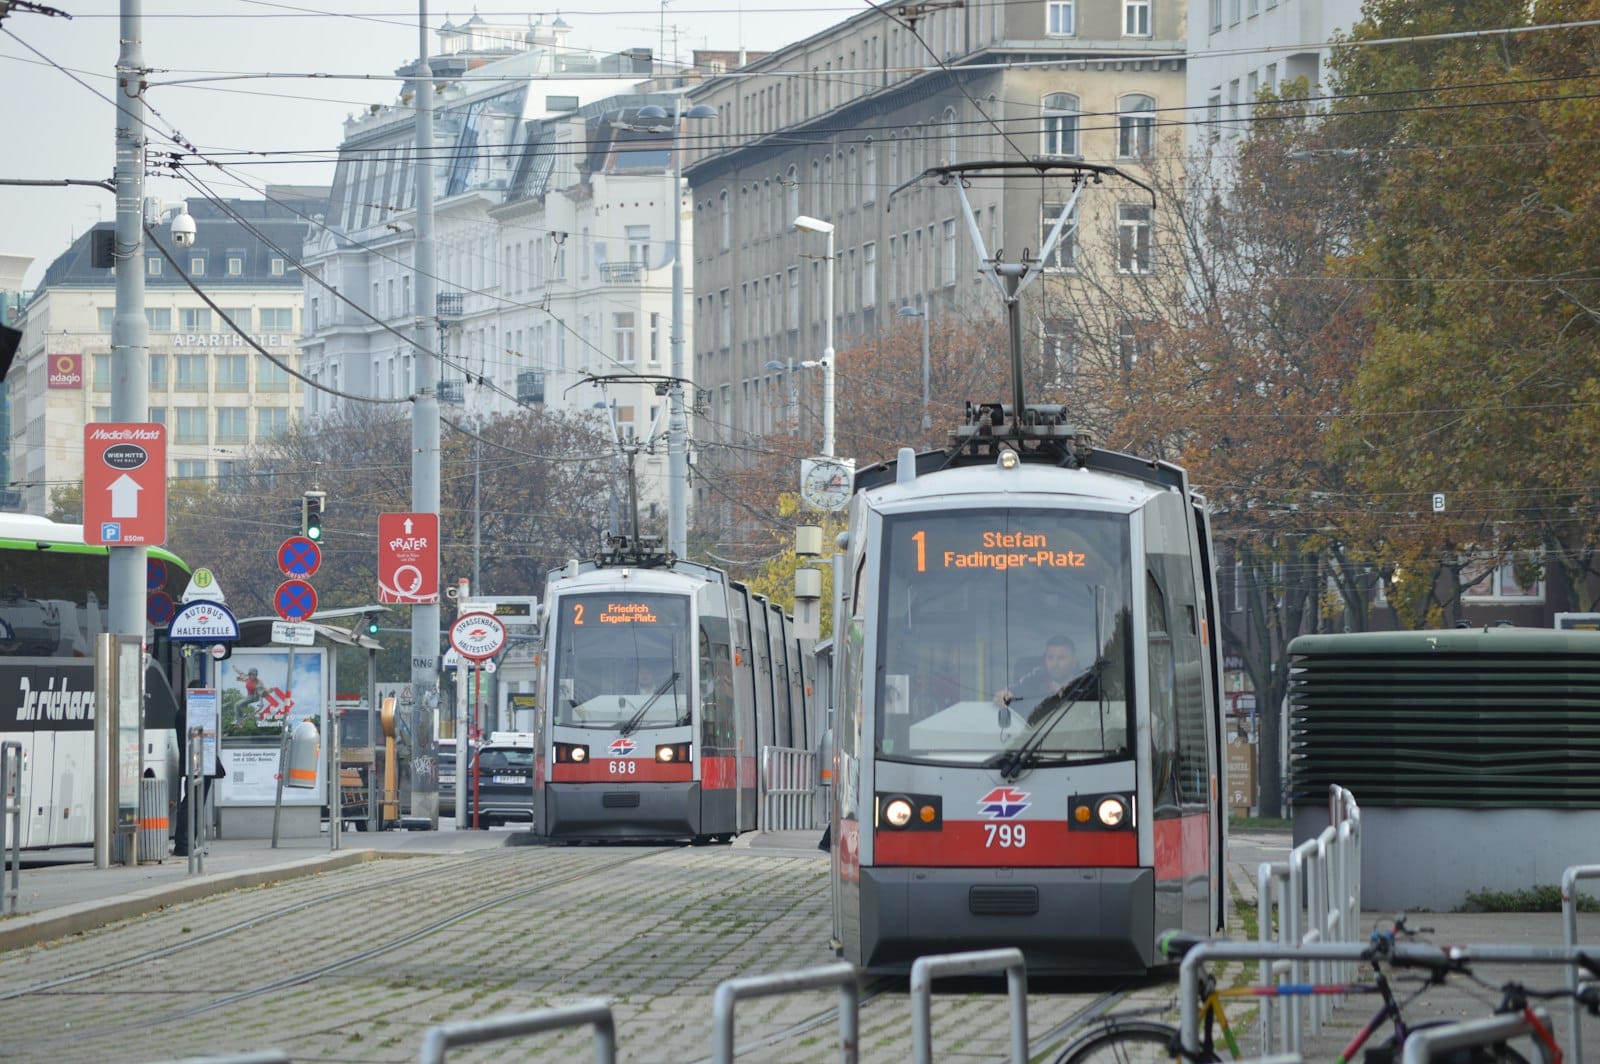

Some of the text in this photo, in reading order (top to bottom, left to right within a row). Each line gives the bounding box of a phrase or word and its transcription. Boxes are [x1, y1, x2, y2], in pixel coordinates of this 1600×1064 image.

[174, 334, 289, 347] APARTHOTEL
[50, 373, 81, 384] adagio
[1435, 497, 1443, 508] B
[106, 528, 116, 539] P
[983, 532, 1047, 548] Stefan
[389, 537, 428, 551] PRATER
[912, 531, 926, 572] 1
[944, 551, 1086, 570] Fadinger-Platz
[198, 572, 208, 584] H
[184, 606, 223, 620] AUTOBUS
[574, 603, 584, 625] 2
[608, 603, 649, 613] Friedrich
[176, 626, 230, 636] HALTESTELLE
[456, 617, 500, 633] STRASSENBAHN
[458, 639, 498, 654] HALTESTELLE
[609, 761, 636, 774] 688
[984, 823, 1026, 848] 799
